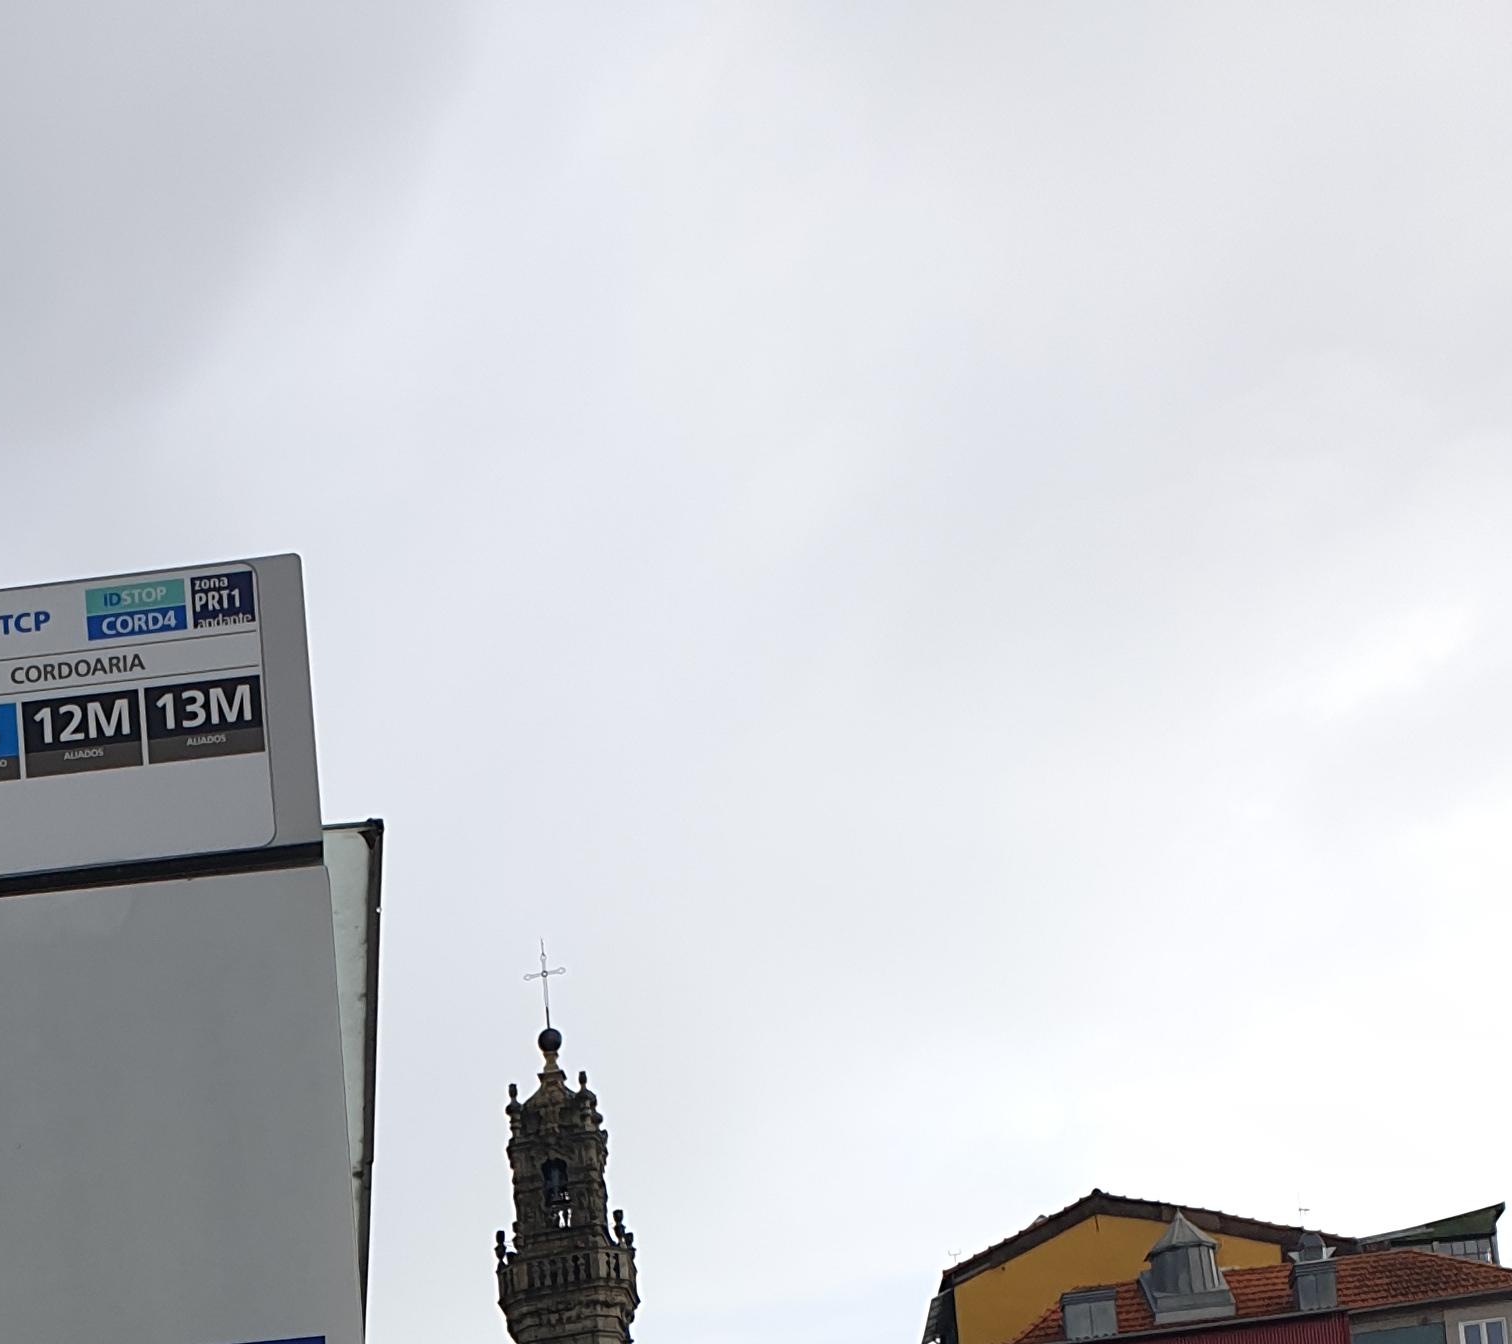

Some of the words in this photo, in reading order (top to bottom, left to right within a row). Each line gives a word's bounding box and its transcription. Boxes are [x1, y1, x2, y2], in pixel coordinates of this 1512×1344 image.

[194, 577, 228, 590] zona
[195, 589, 240, 613] PRT1
[101, 610, 177, 635] CORD4
[197, 612, 252, 629] andante
[10, 653, 146, 684] CORDOARIA
[155, 683, 253, 731] 13M
[32, 698, 131, 744] 12M
[186, 733, 226, 746] ALIADOS
[63, 748, 104, 761] ALIADOS
